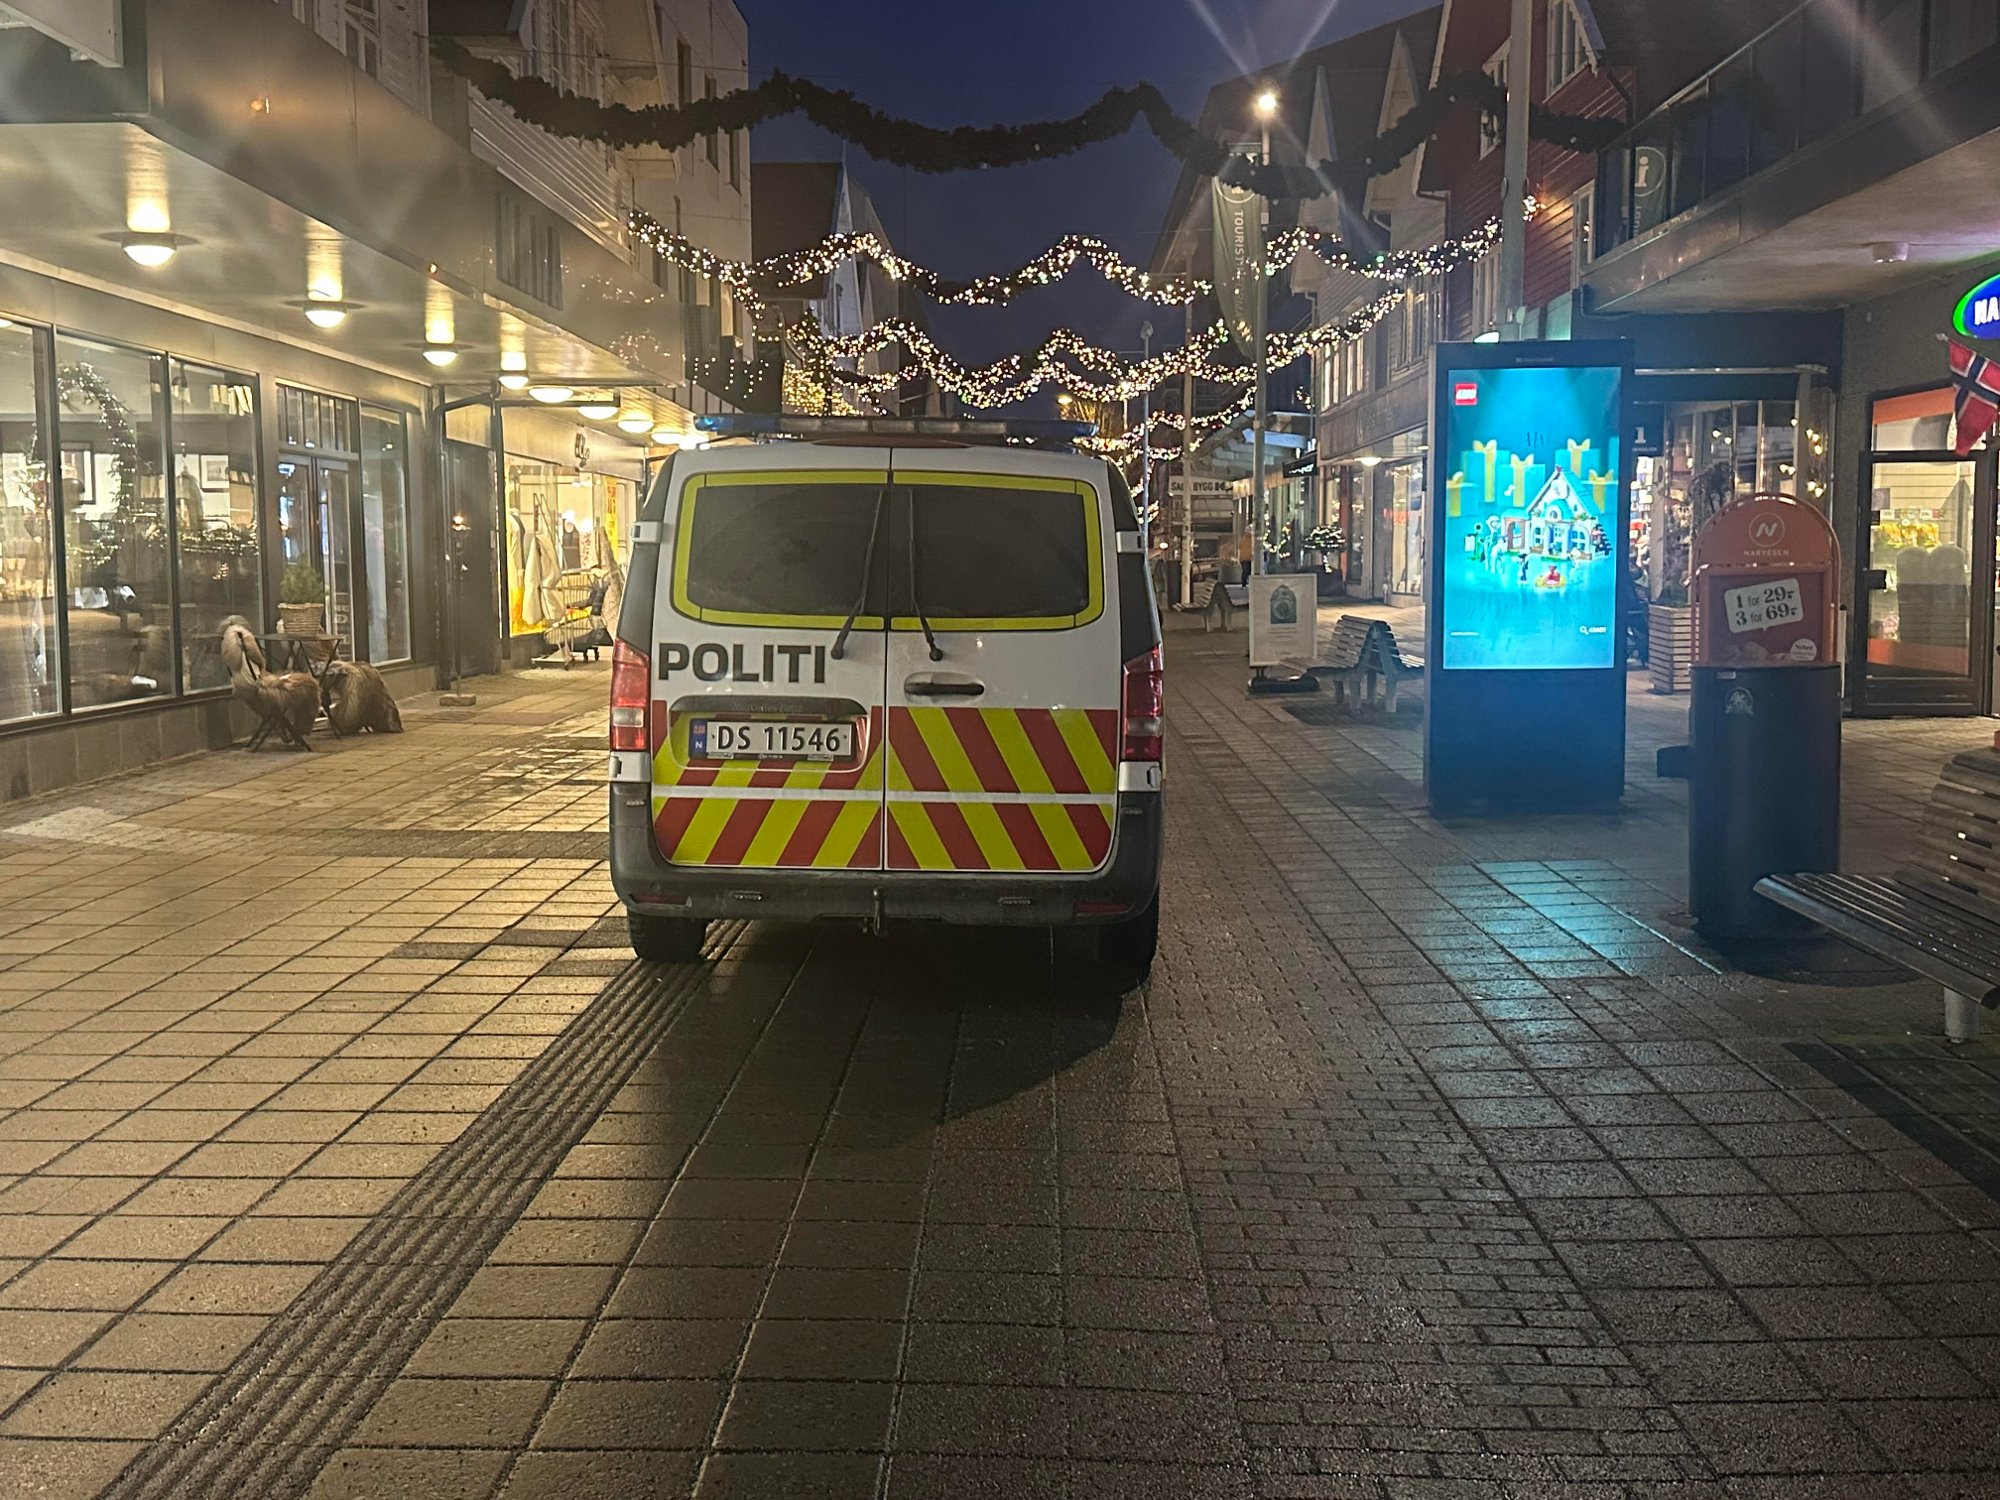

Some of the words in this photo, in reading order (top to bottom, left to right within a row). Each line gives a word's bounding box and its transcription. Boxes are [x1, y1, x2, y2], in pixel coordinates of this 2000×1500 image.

[1736, 594, 1744, 609] 1
[1747, 595, 1760, 607] for
[1735, 611, 1747, 626] 3
[1750, 612, 1763, 624] for
[658, 643, 826, 684] POLITI
[718, 726, 751, 750] DS
[764, 726, 841, 752] 11546
